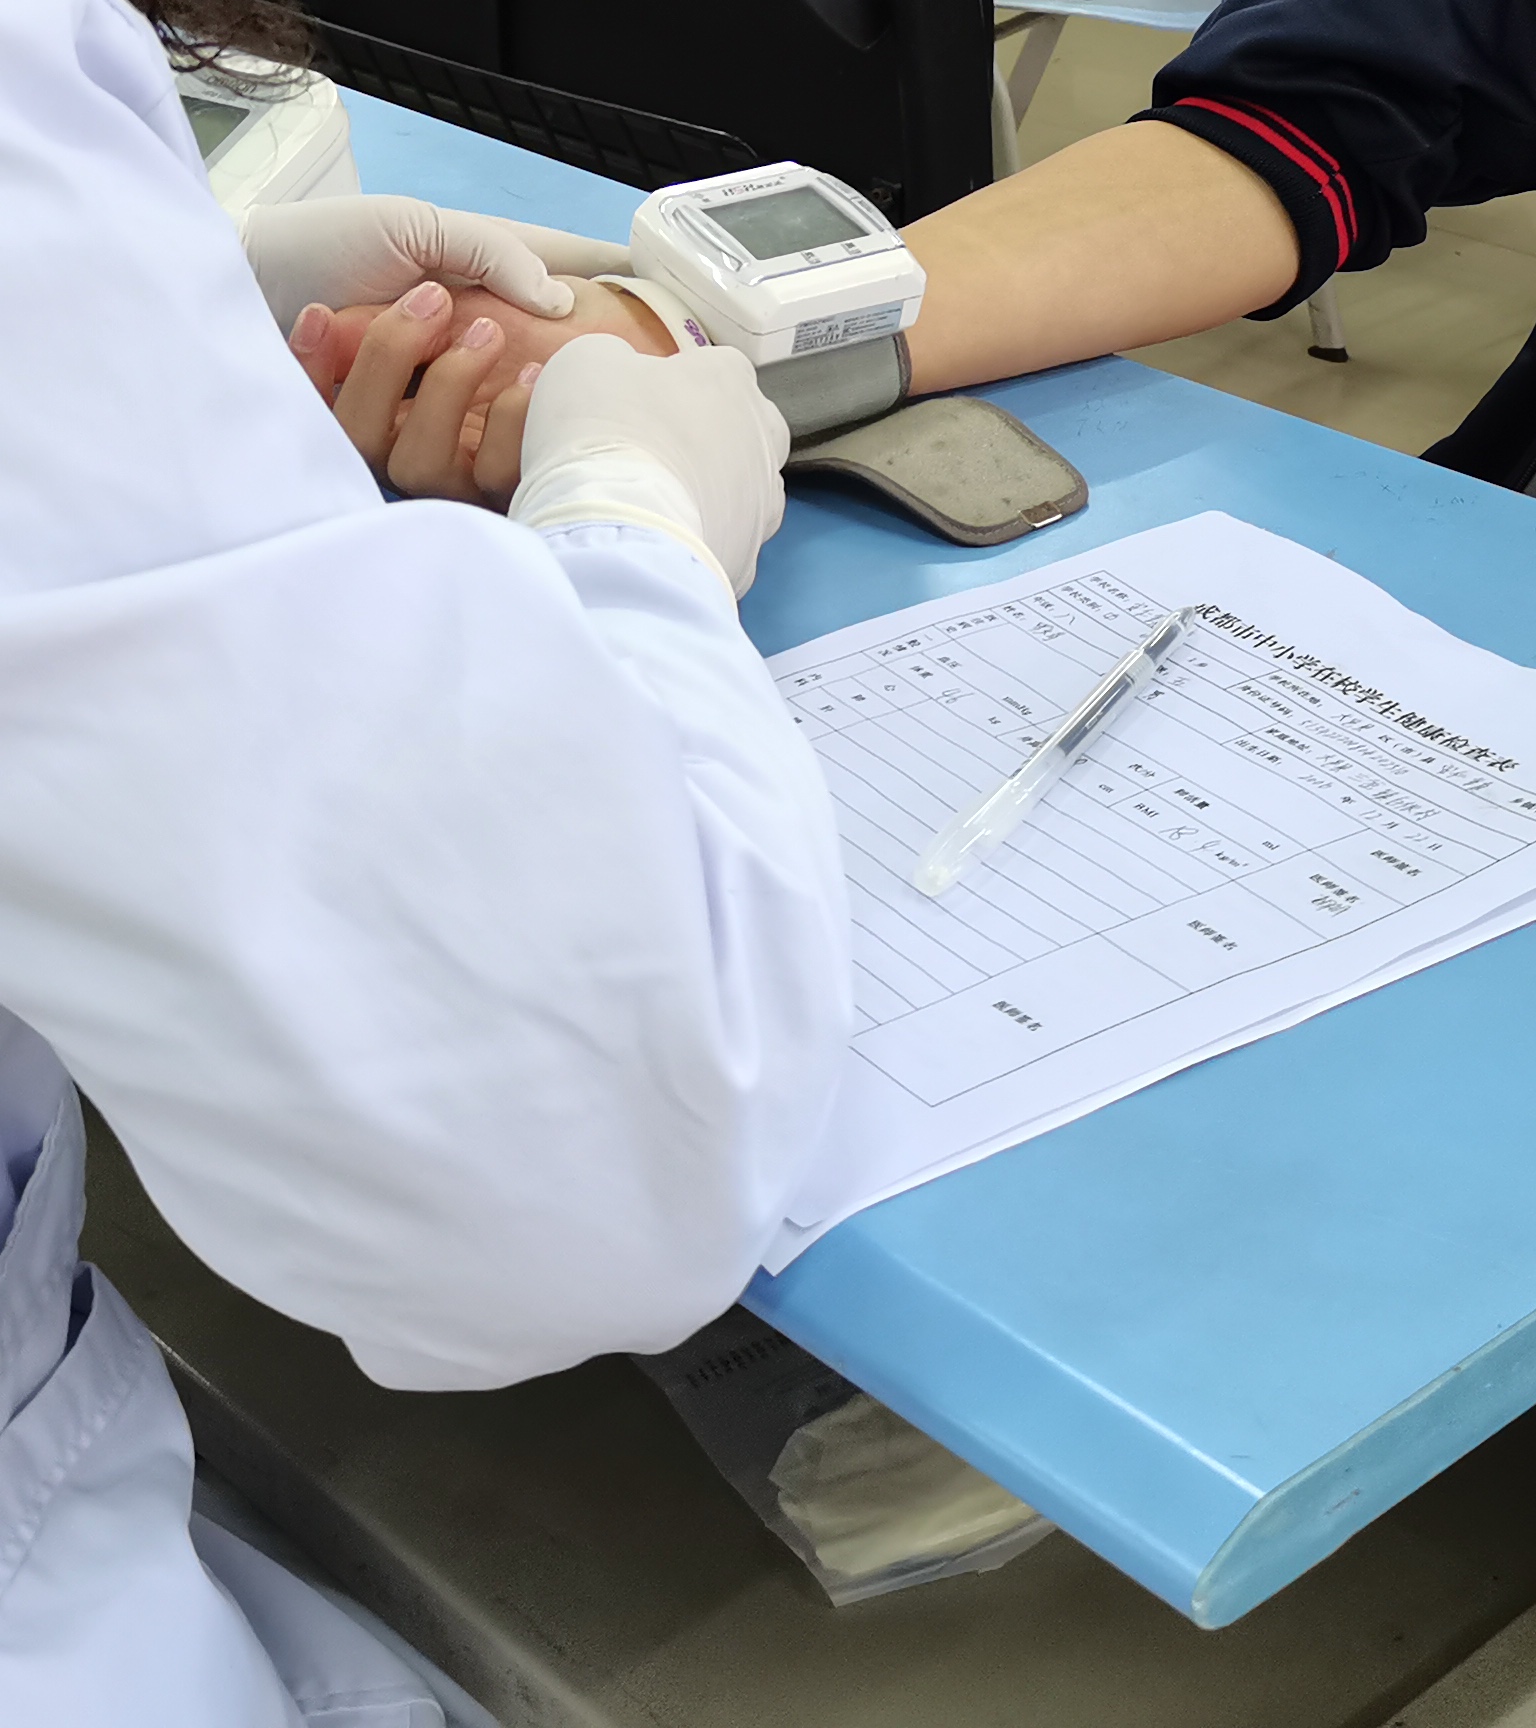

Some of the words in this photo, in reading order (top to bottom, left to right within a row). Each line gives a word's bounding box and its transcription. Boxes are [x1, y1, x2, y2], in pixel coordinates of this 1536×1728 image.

[1195, 604, 1520, 772] 成都市中小学在校学生健康检查表
